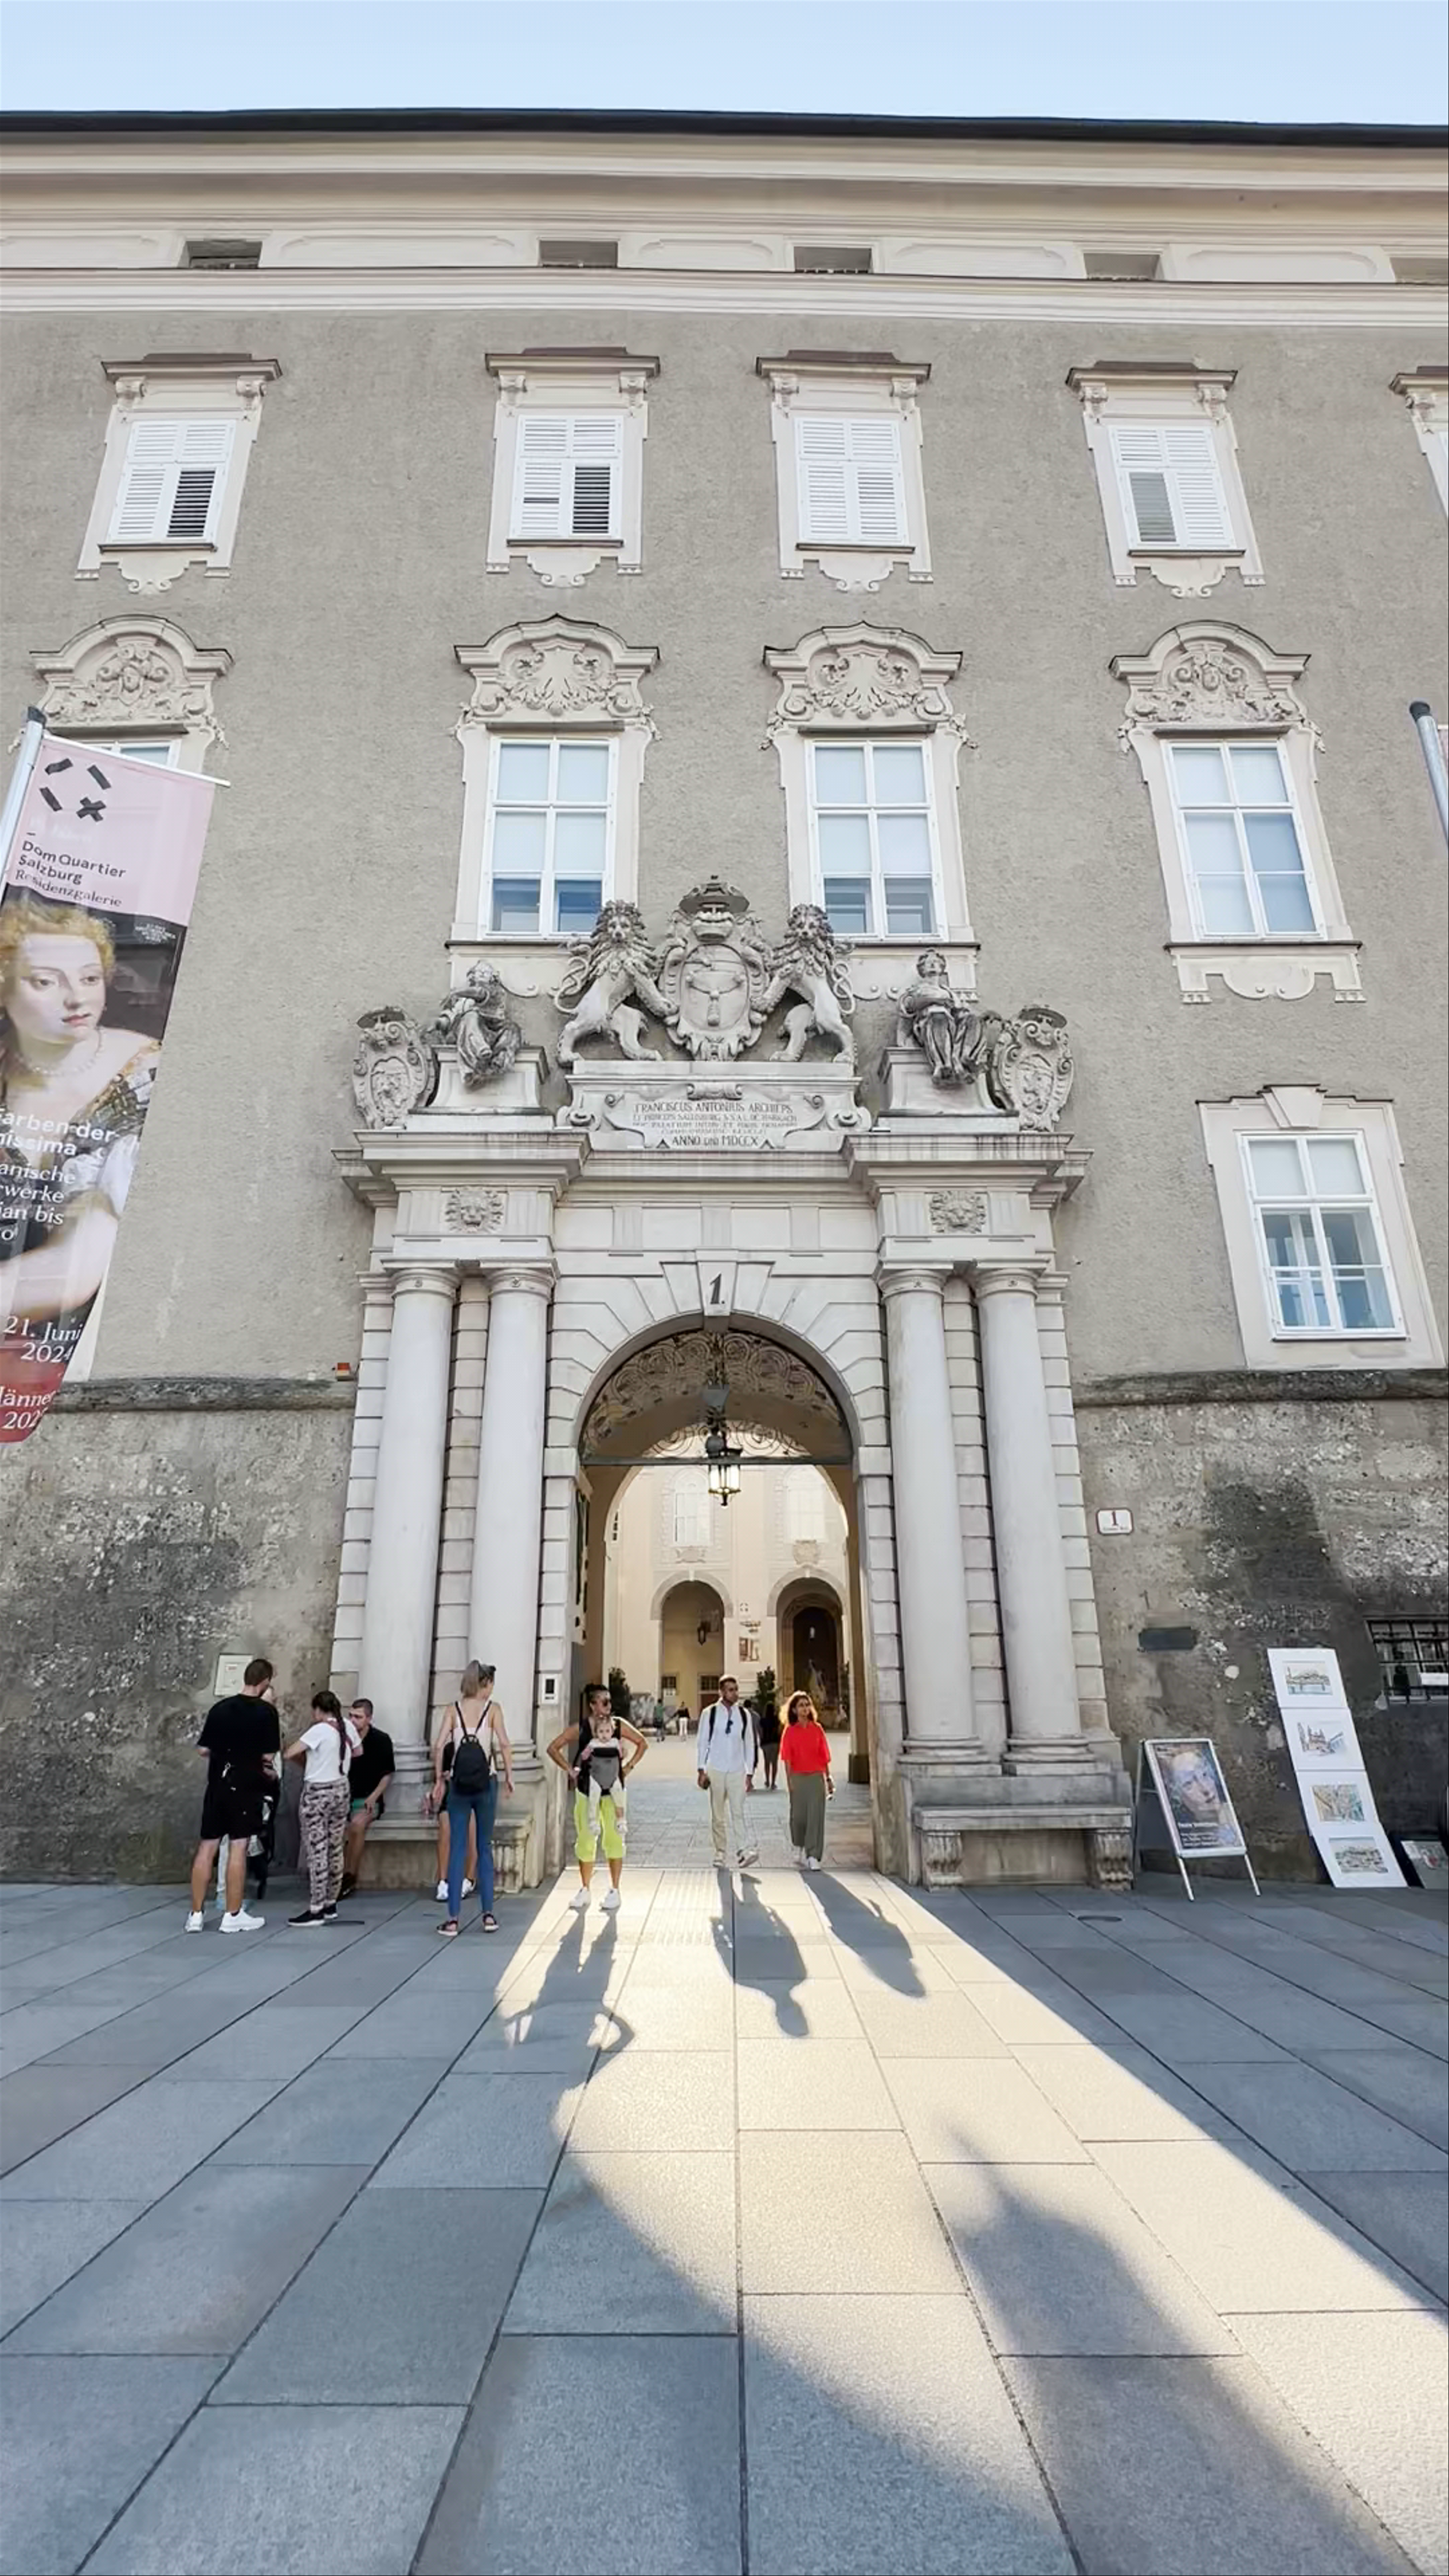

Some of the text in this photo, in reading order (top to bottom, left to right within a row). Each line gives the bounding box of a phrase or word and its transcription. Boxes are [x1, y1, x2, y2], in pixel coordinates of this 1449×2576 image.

[18, 854, 83, 885] Salzburg
[15, 869, 122, 907] Residenzgalerie
[75, 1119, 116, 1142] der
[672, 1135, 701, 1146] ANNO
[35, 1205, 64, 1225] bis
[3, 1315, 83, 1344] 21. Juni
[20, 1342, 74, 1363] 2024
[1111, 1511, 1119, 1526] 1
